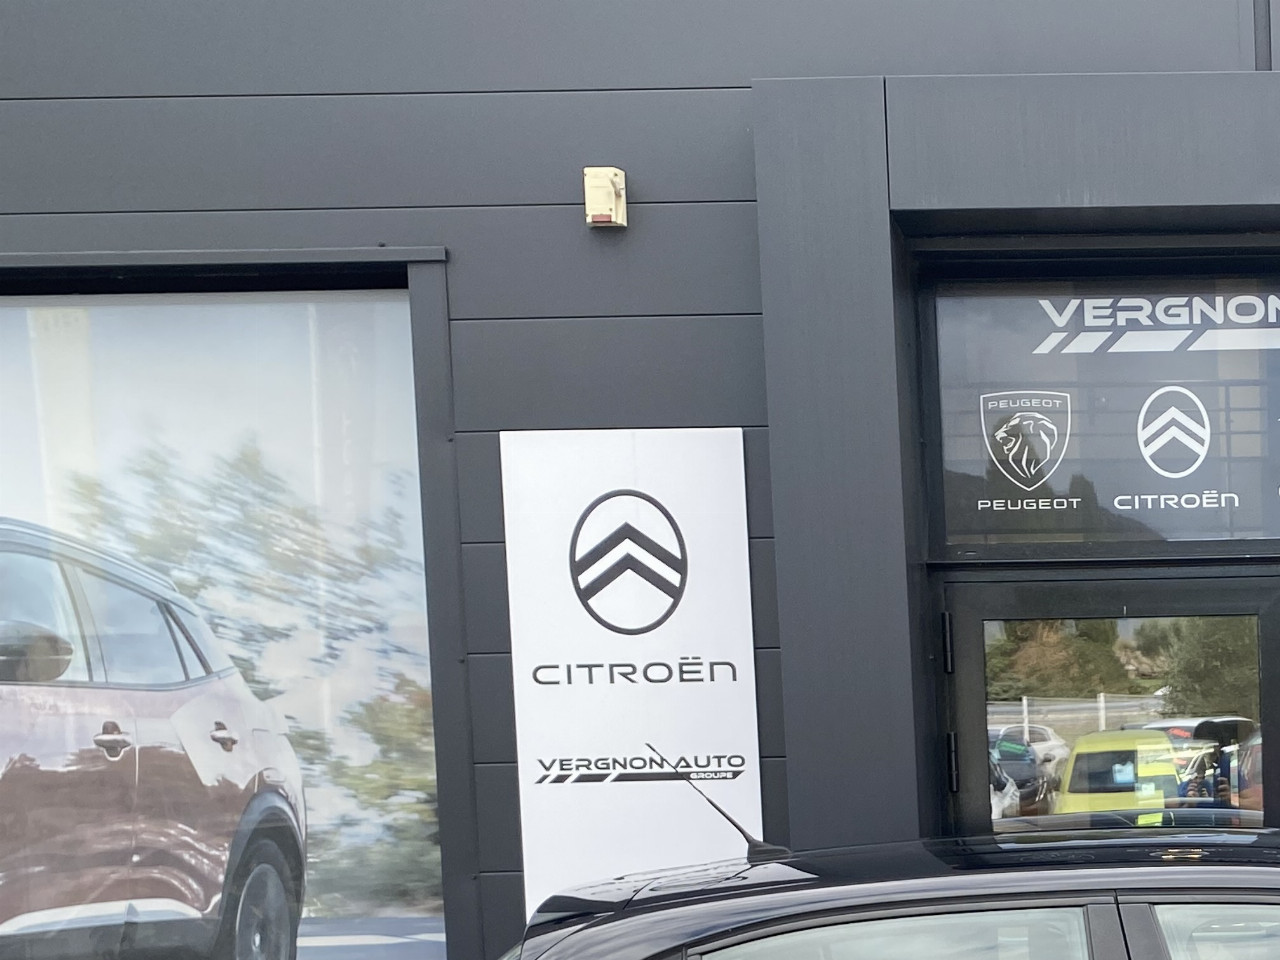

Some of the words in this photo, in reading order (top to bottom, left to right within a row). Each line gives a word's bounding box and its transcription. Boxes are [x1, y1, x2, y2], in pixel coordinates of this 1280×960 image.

[988, 398, 1063, 410] PEUGEOT
[977, 497, 1082, 511] PEUGEOT
[537, 756, 666, 771] VERGNON
[673, 754, 746, 769] AUTO
[689, 771, 734, 780] GROUPE
